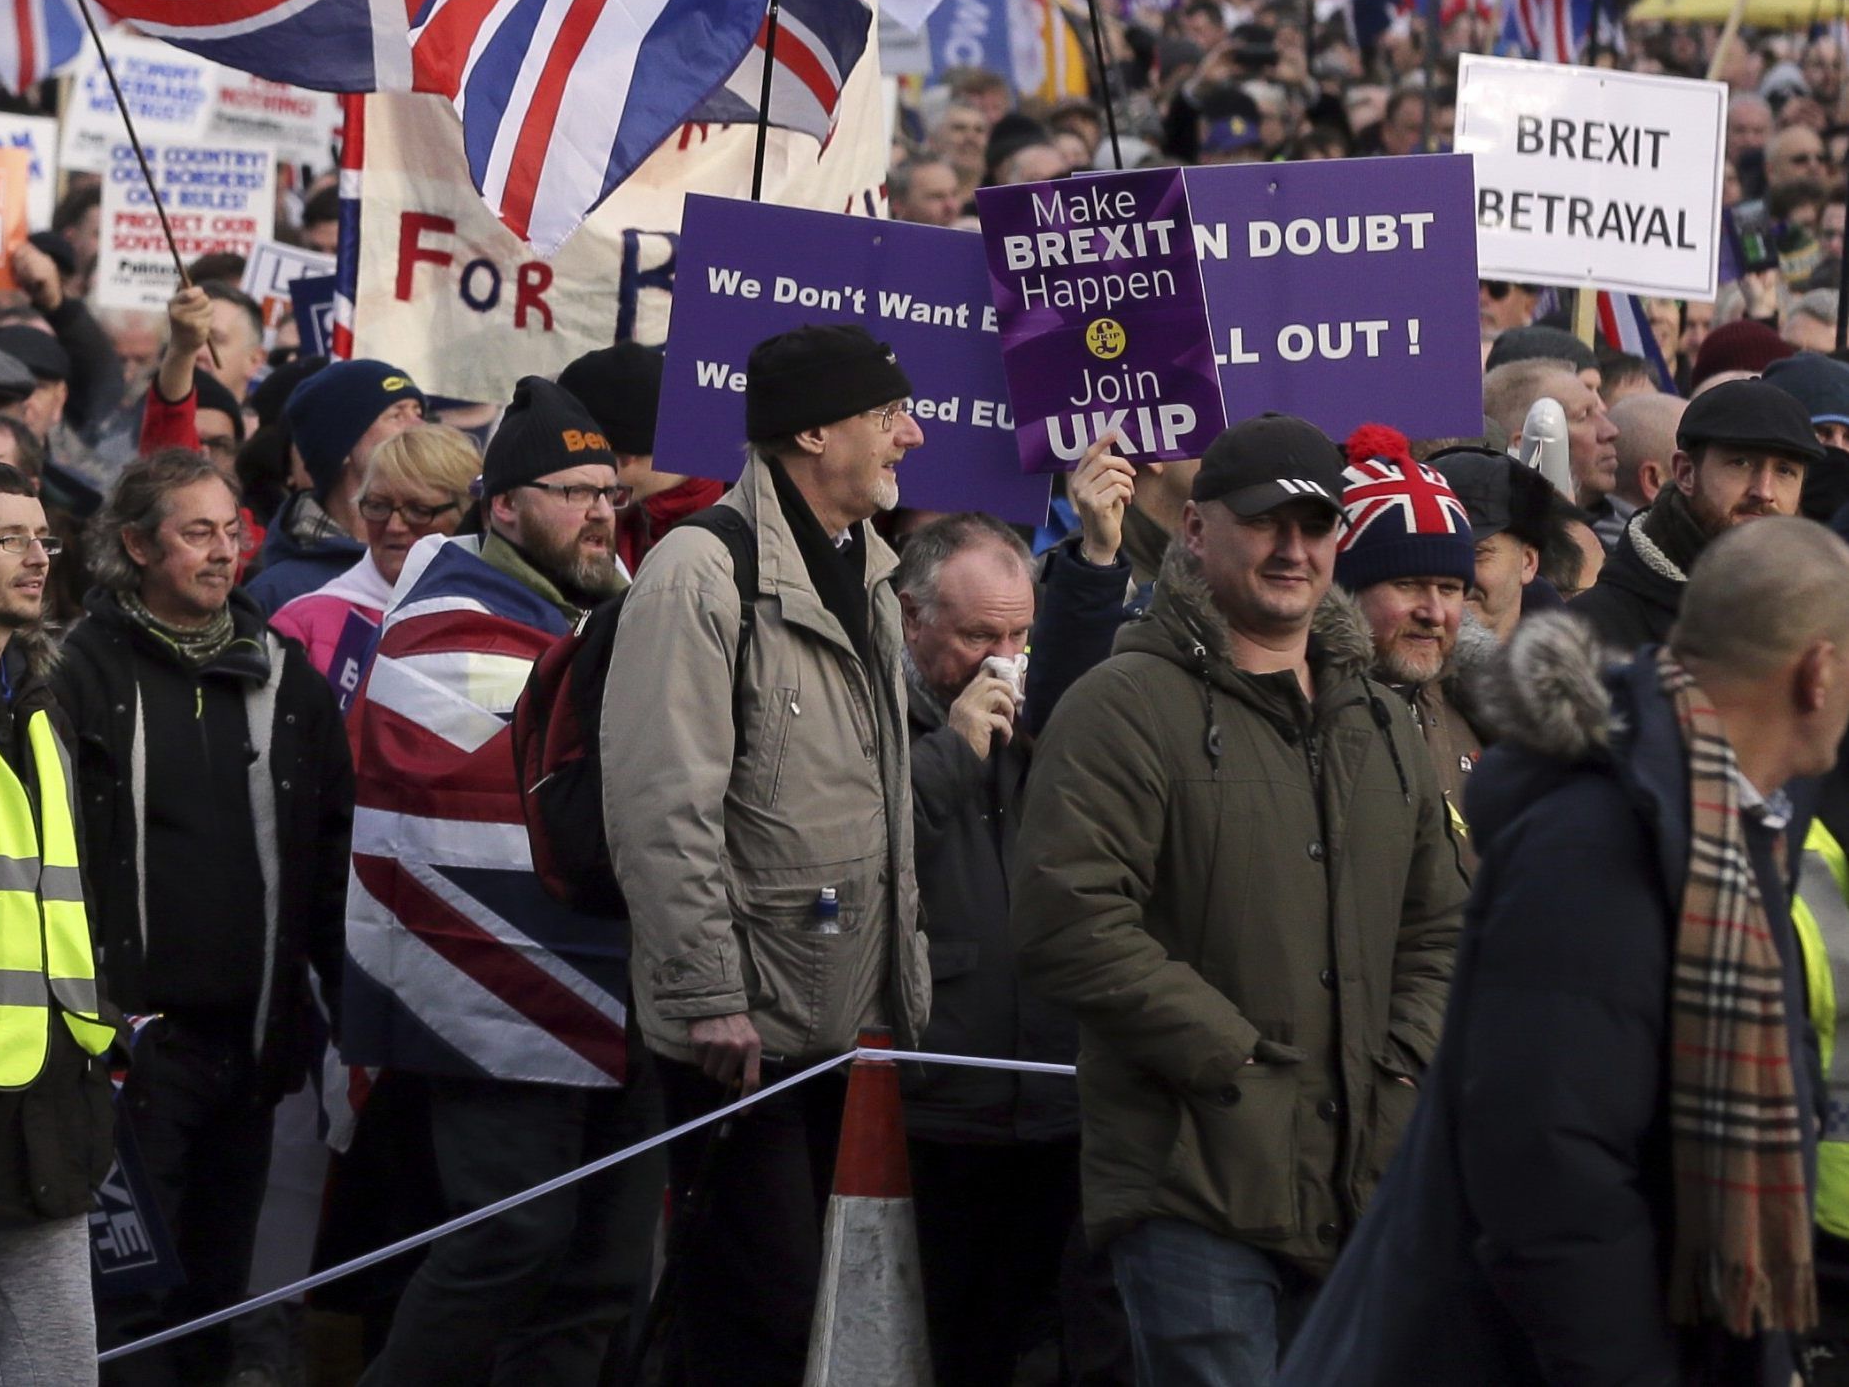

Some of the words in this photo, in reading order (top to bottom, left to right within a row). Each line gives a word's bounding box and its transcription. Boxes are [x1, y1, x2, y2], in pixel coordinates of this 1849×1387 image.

[1516, 115, 1670, 168] BREXIT
[1031, 185, 1137, 228] Make
[1477, 187, 1698, 251] BETRAYAL
[1003, 219, 1175, 271] BREXIT
[1248, 212, 1435, 258] DOUBT
[396, 211, 555, 332] FOR
[1020, 269, 1176, 313] Happen
[708, 267, 761, 299] We
[773, 277, 866, 314] Don't
[878, 291, 969, 329] Want
[1090, 332, 1120, 342] UKIP
[1276, 320, 1390, 362] OUT
[696, 361, 748, 393] We
[1069, 364, 1161, 407] Join
[1045, 403, 1197, 462] UKIP
